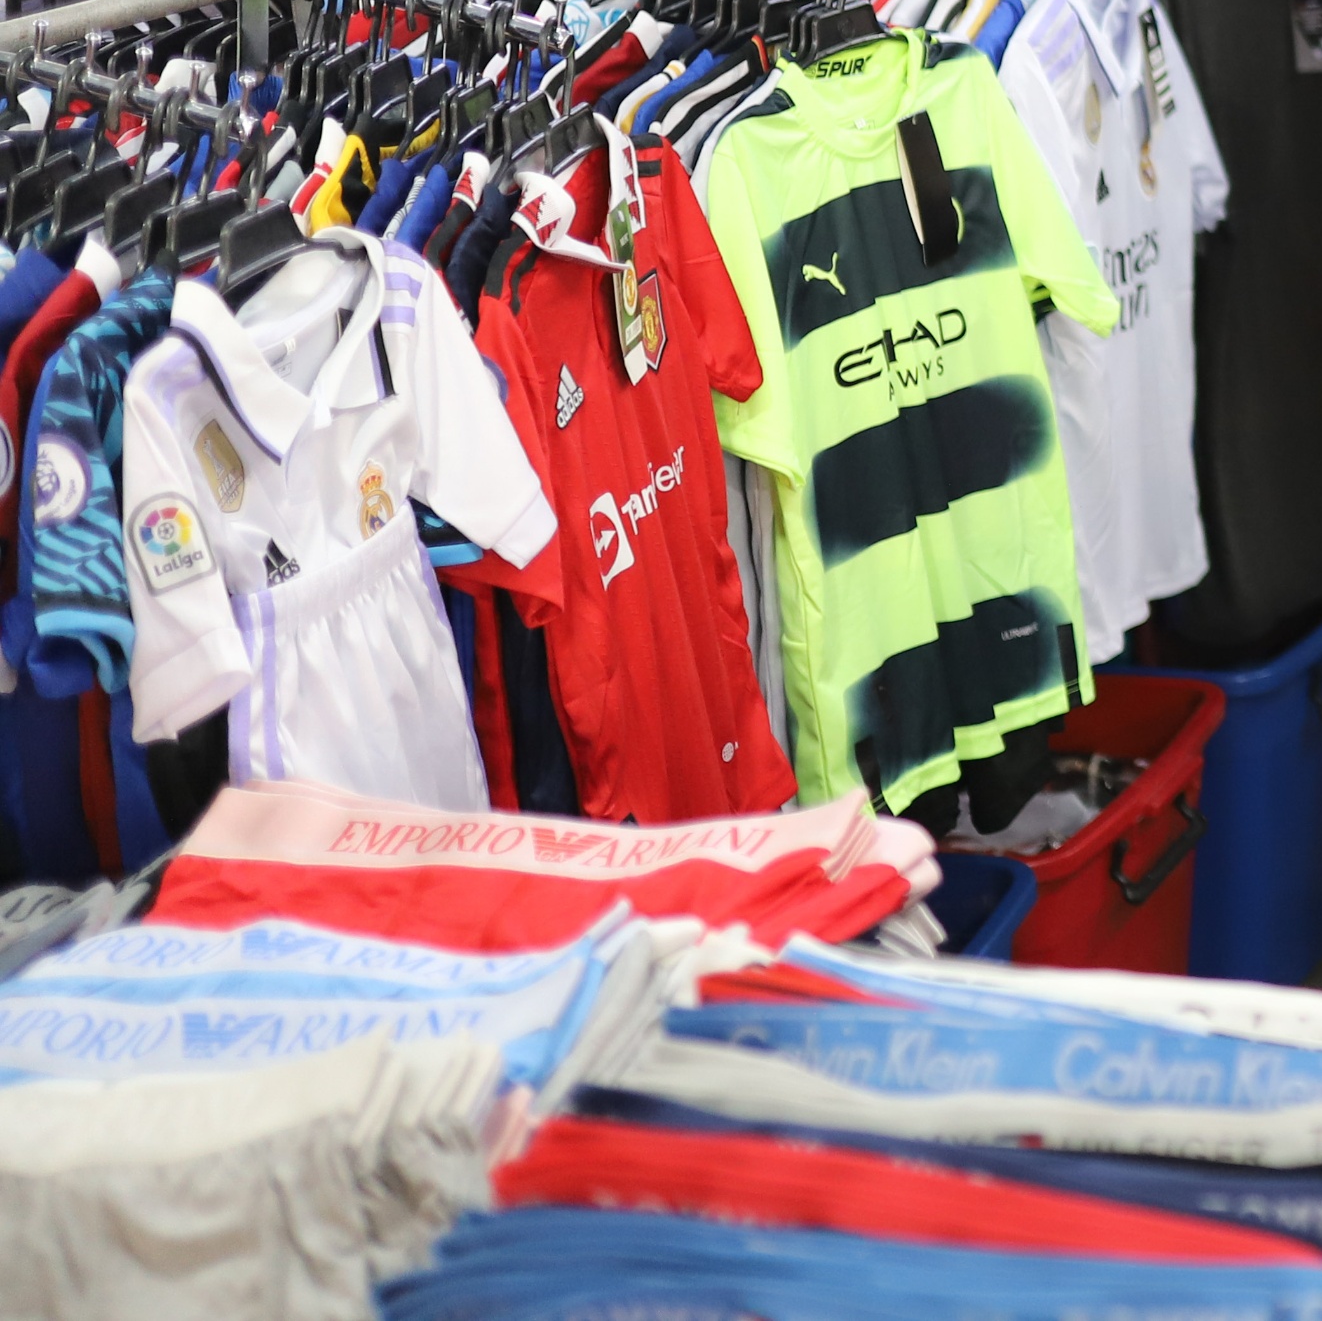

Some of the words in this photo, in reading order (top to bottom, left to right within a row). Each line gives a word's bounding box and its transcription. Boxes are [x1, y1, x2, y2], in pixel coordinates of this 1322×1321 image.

[815, 55, 872, 79] SPUR
[556, 386, 585, 429] adidas
[327, 820, 526, 856] EMPORIO
[582, 828, 775, 868] ARMANI
[1053, 1033, 1225, 1100] Calvin
